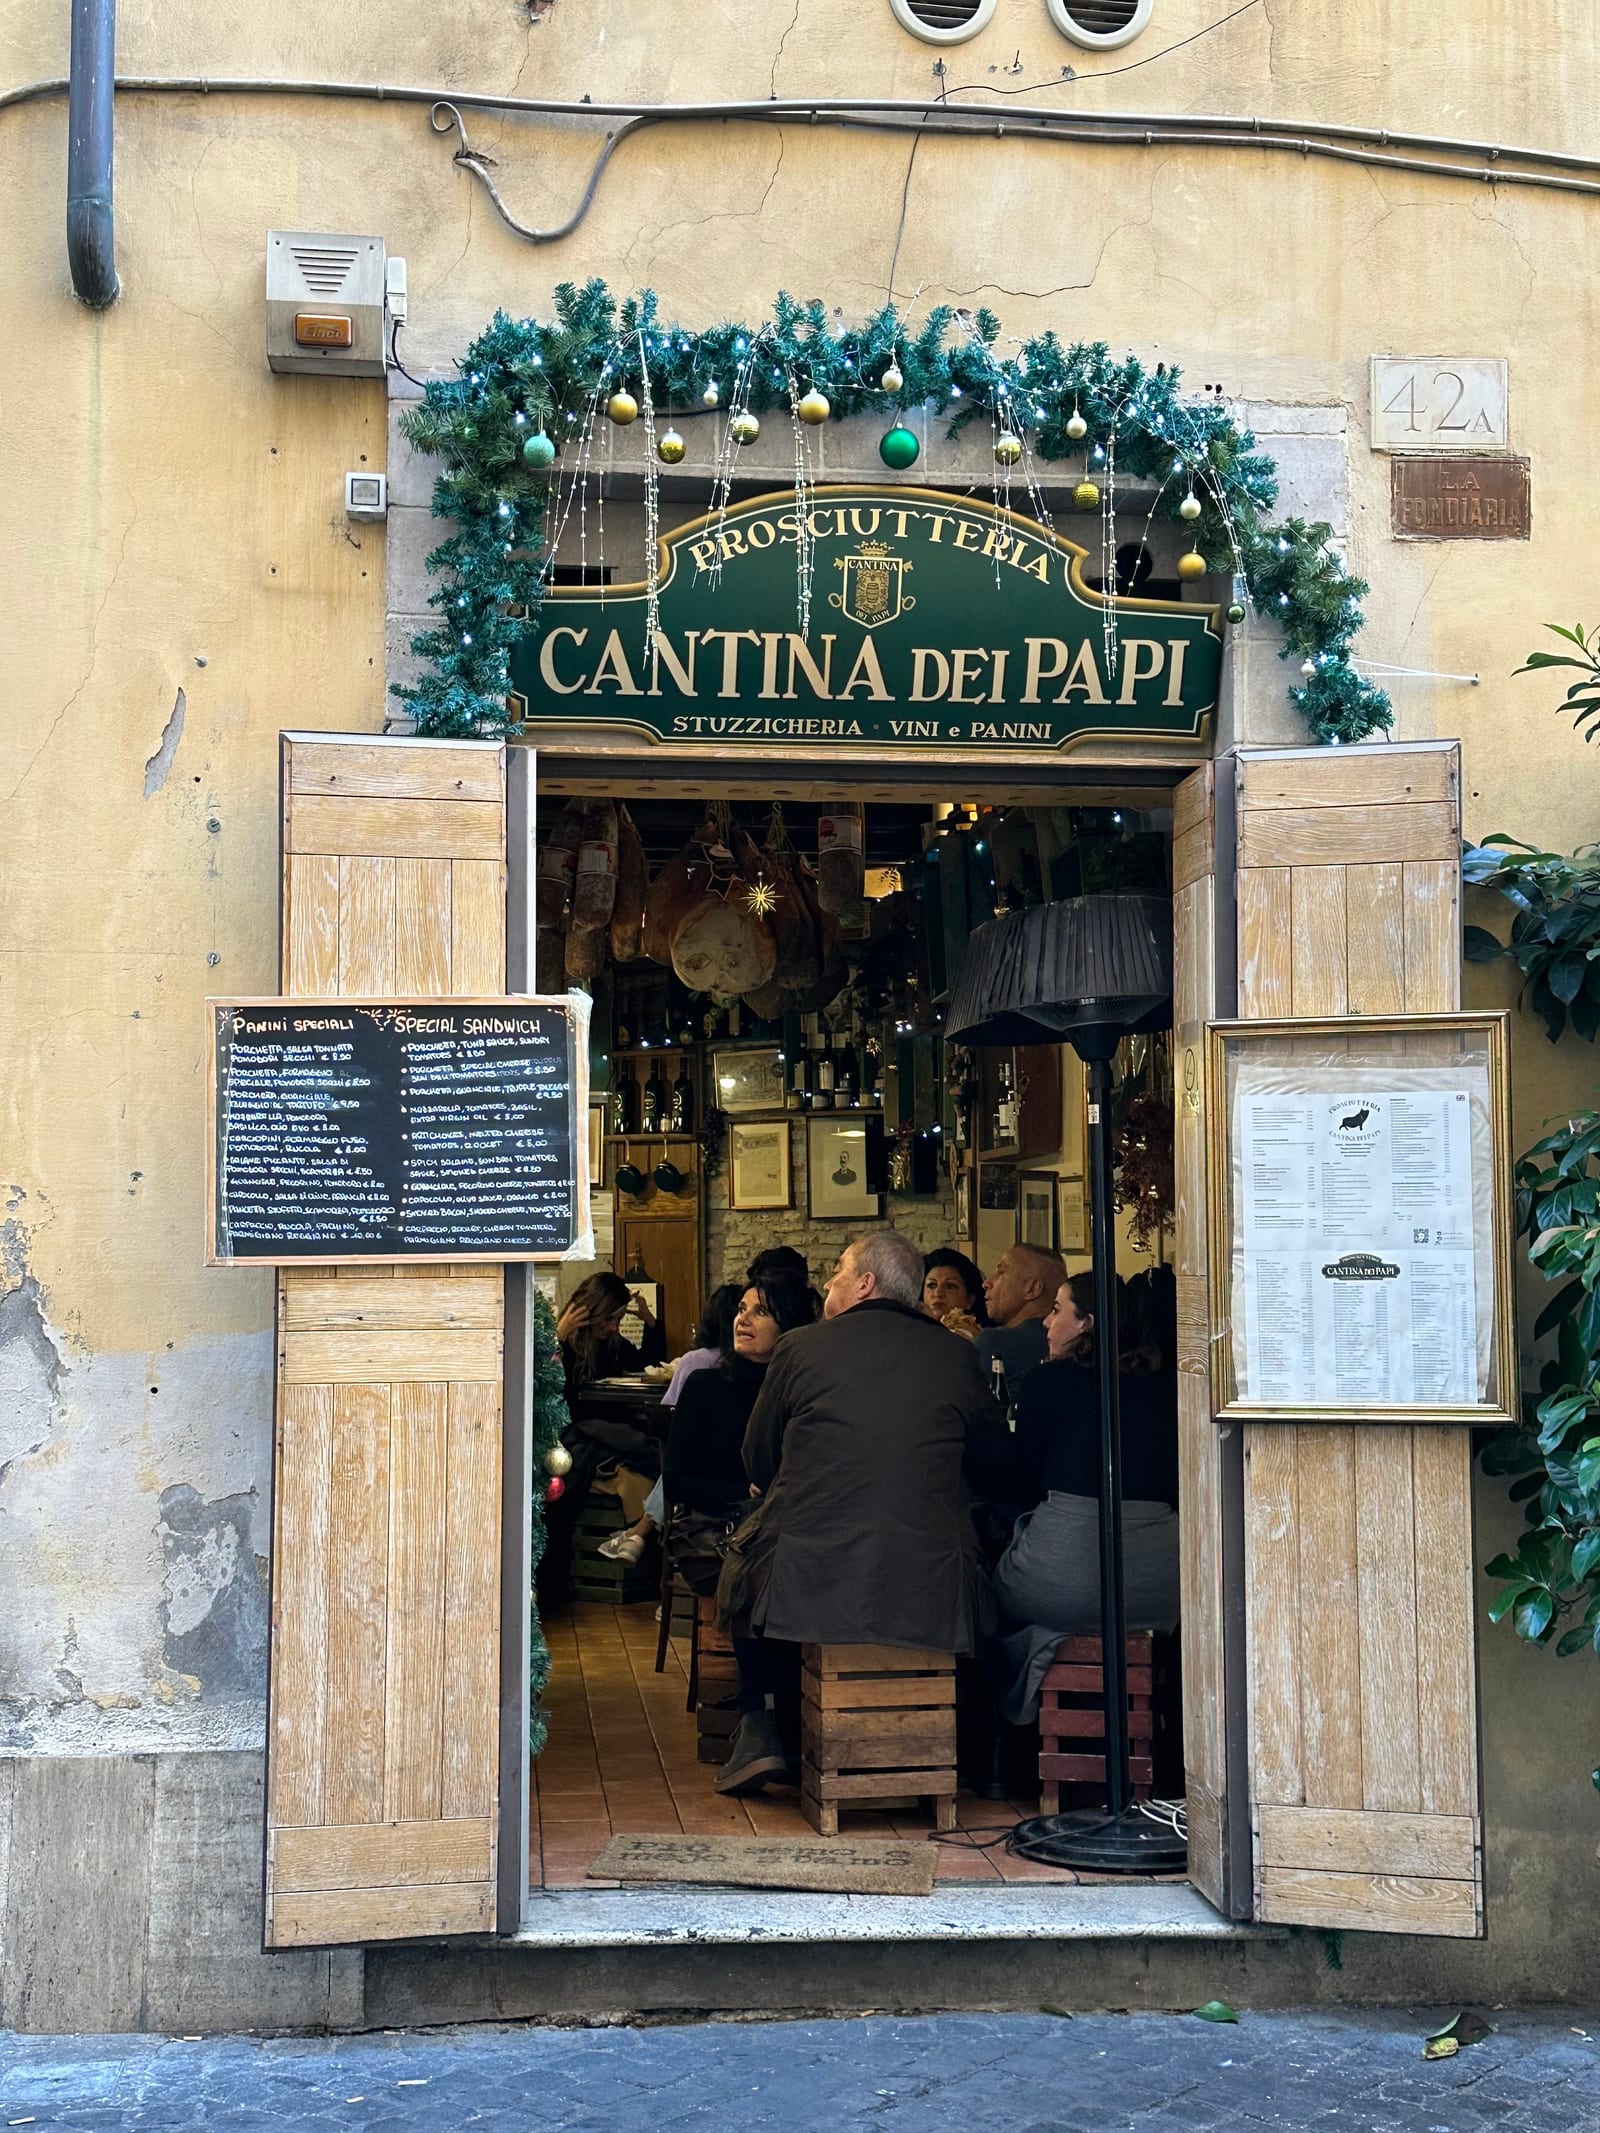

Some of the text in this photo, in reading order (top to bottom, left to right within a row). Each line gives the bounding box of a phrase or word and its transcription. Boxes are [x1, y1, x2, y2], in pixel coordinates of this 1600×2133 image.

[1440, 471, 1480, 490] LA
[1400, 497, 1521, 528] FONDIARIA
[688, 508, 1050, 585] PROSCIUTTERIA
[848, 560, 898, 571] CANTINA
[856, 608, 890, 622] DEI PAPI
[539, 627, 1191, 706] CANTINA DEI PAPI
[672, 716, 1053, 740] STUZZICHERIA VINI e PANINI
[294, 1019, 354, 1031] SPECIALI
[395, 1016, 540, 1035] SPECIAL SANDWICH
[1327, 1267, 1364, 1276] CANTINA
[1375, 1267, 1394, 1275] PAPI
